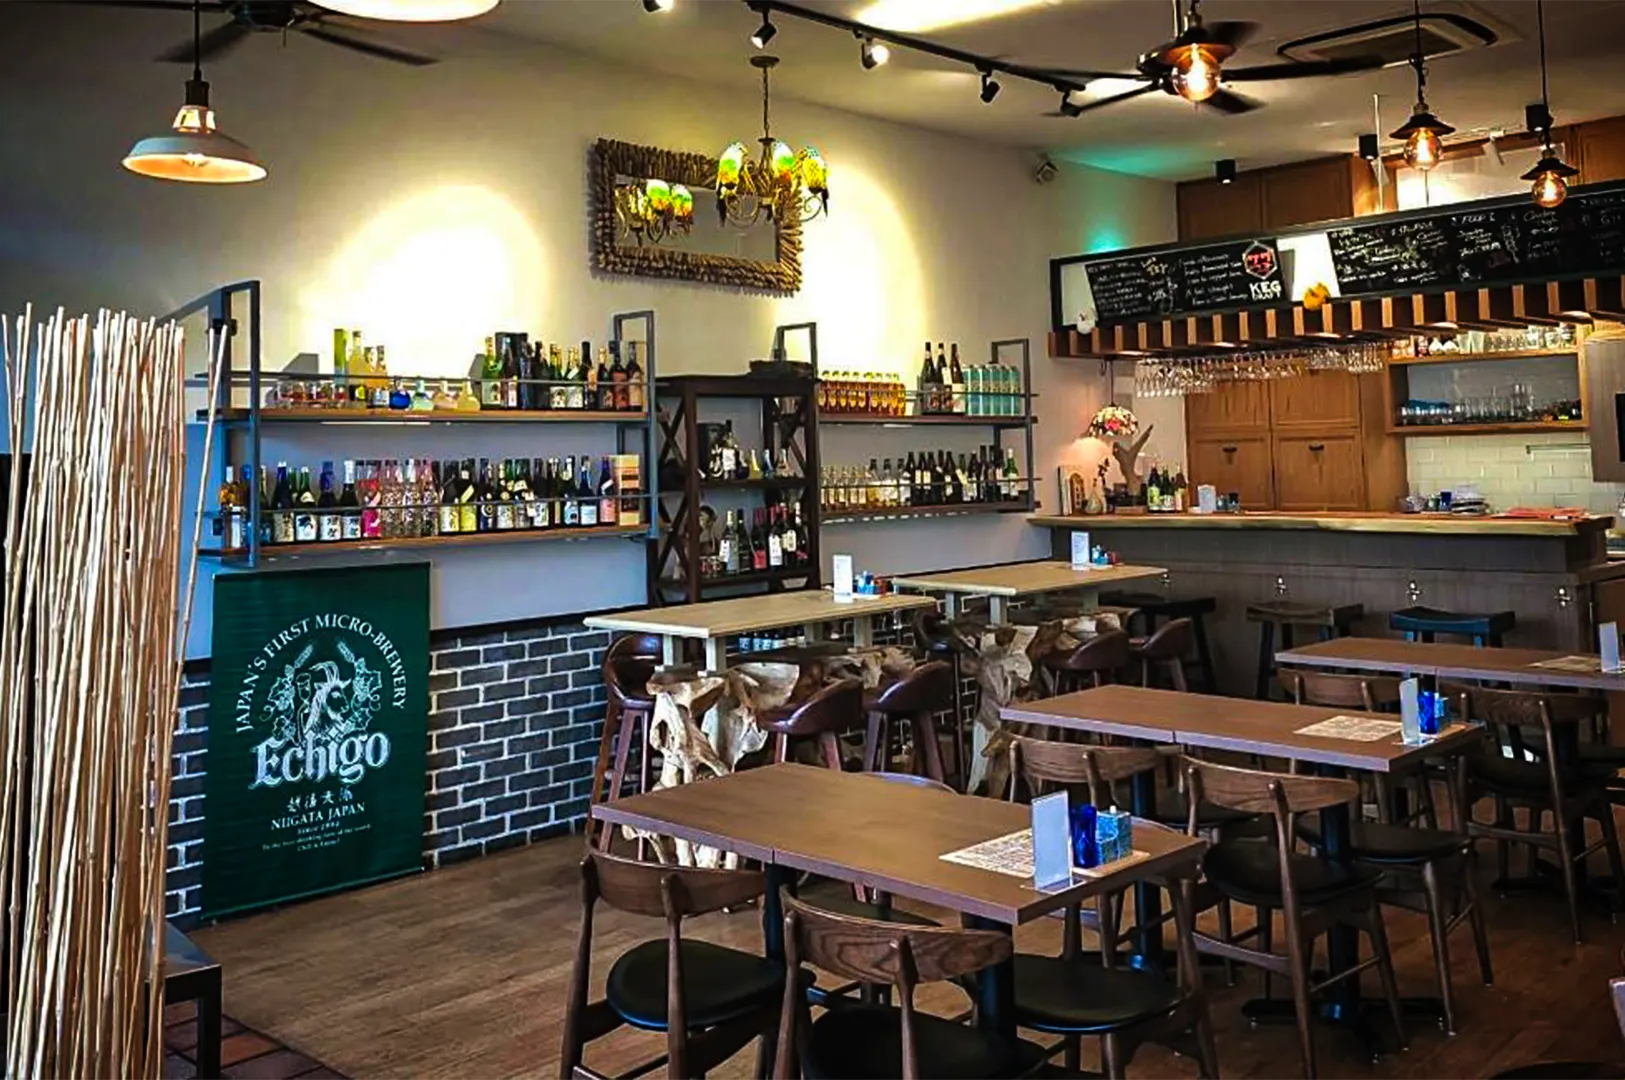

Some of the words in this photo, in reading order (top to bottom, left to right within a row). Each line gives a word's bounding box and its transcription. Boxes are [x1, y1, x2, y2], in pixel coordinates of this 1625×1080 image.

[1248, 279, 1282, 295] KEG
[236, 656, 268, 734] JAPAN'S
[263, 617, 311, 659] FIRST
[314, 613, 408, 710] MICRO-BREWERY
[248, 730, 392, 790] Echigo
[270, 810, 324, 831] NIIGATA
[327, 801, 366, 822] JAPAN
